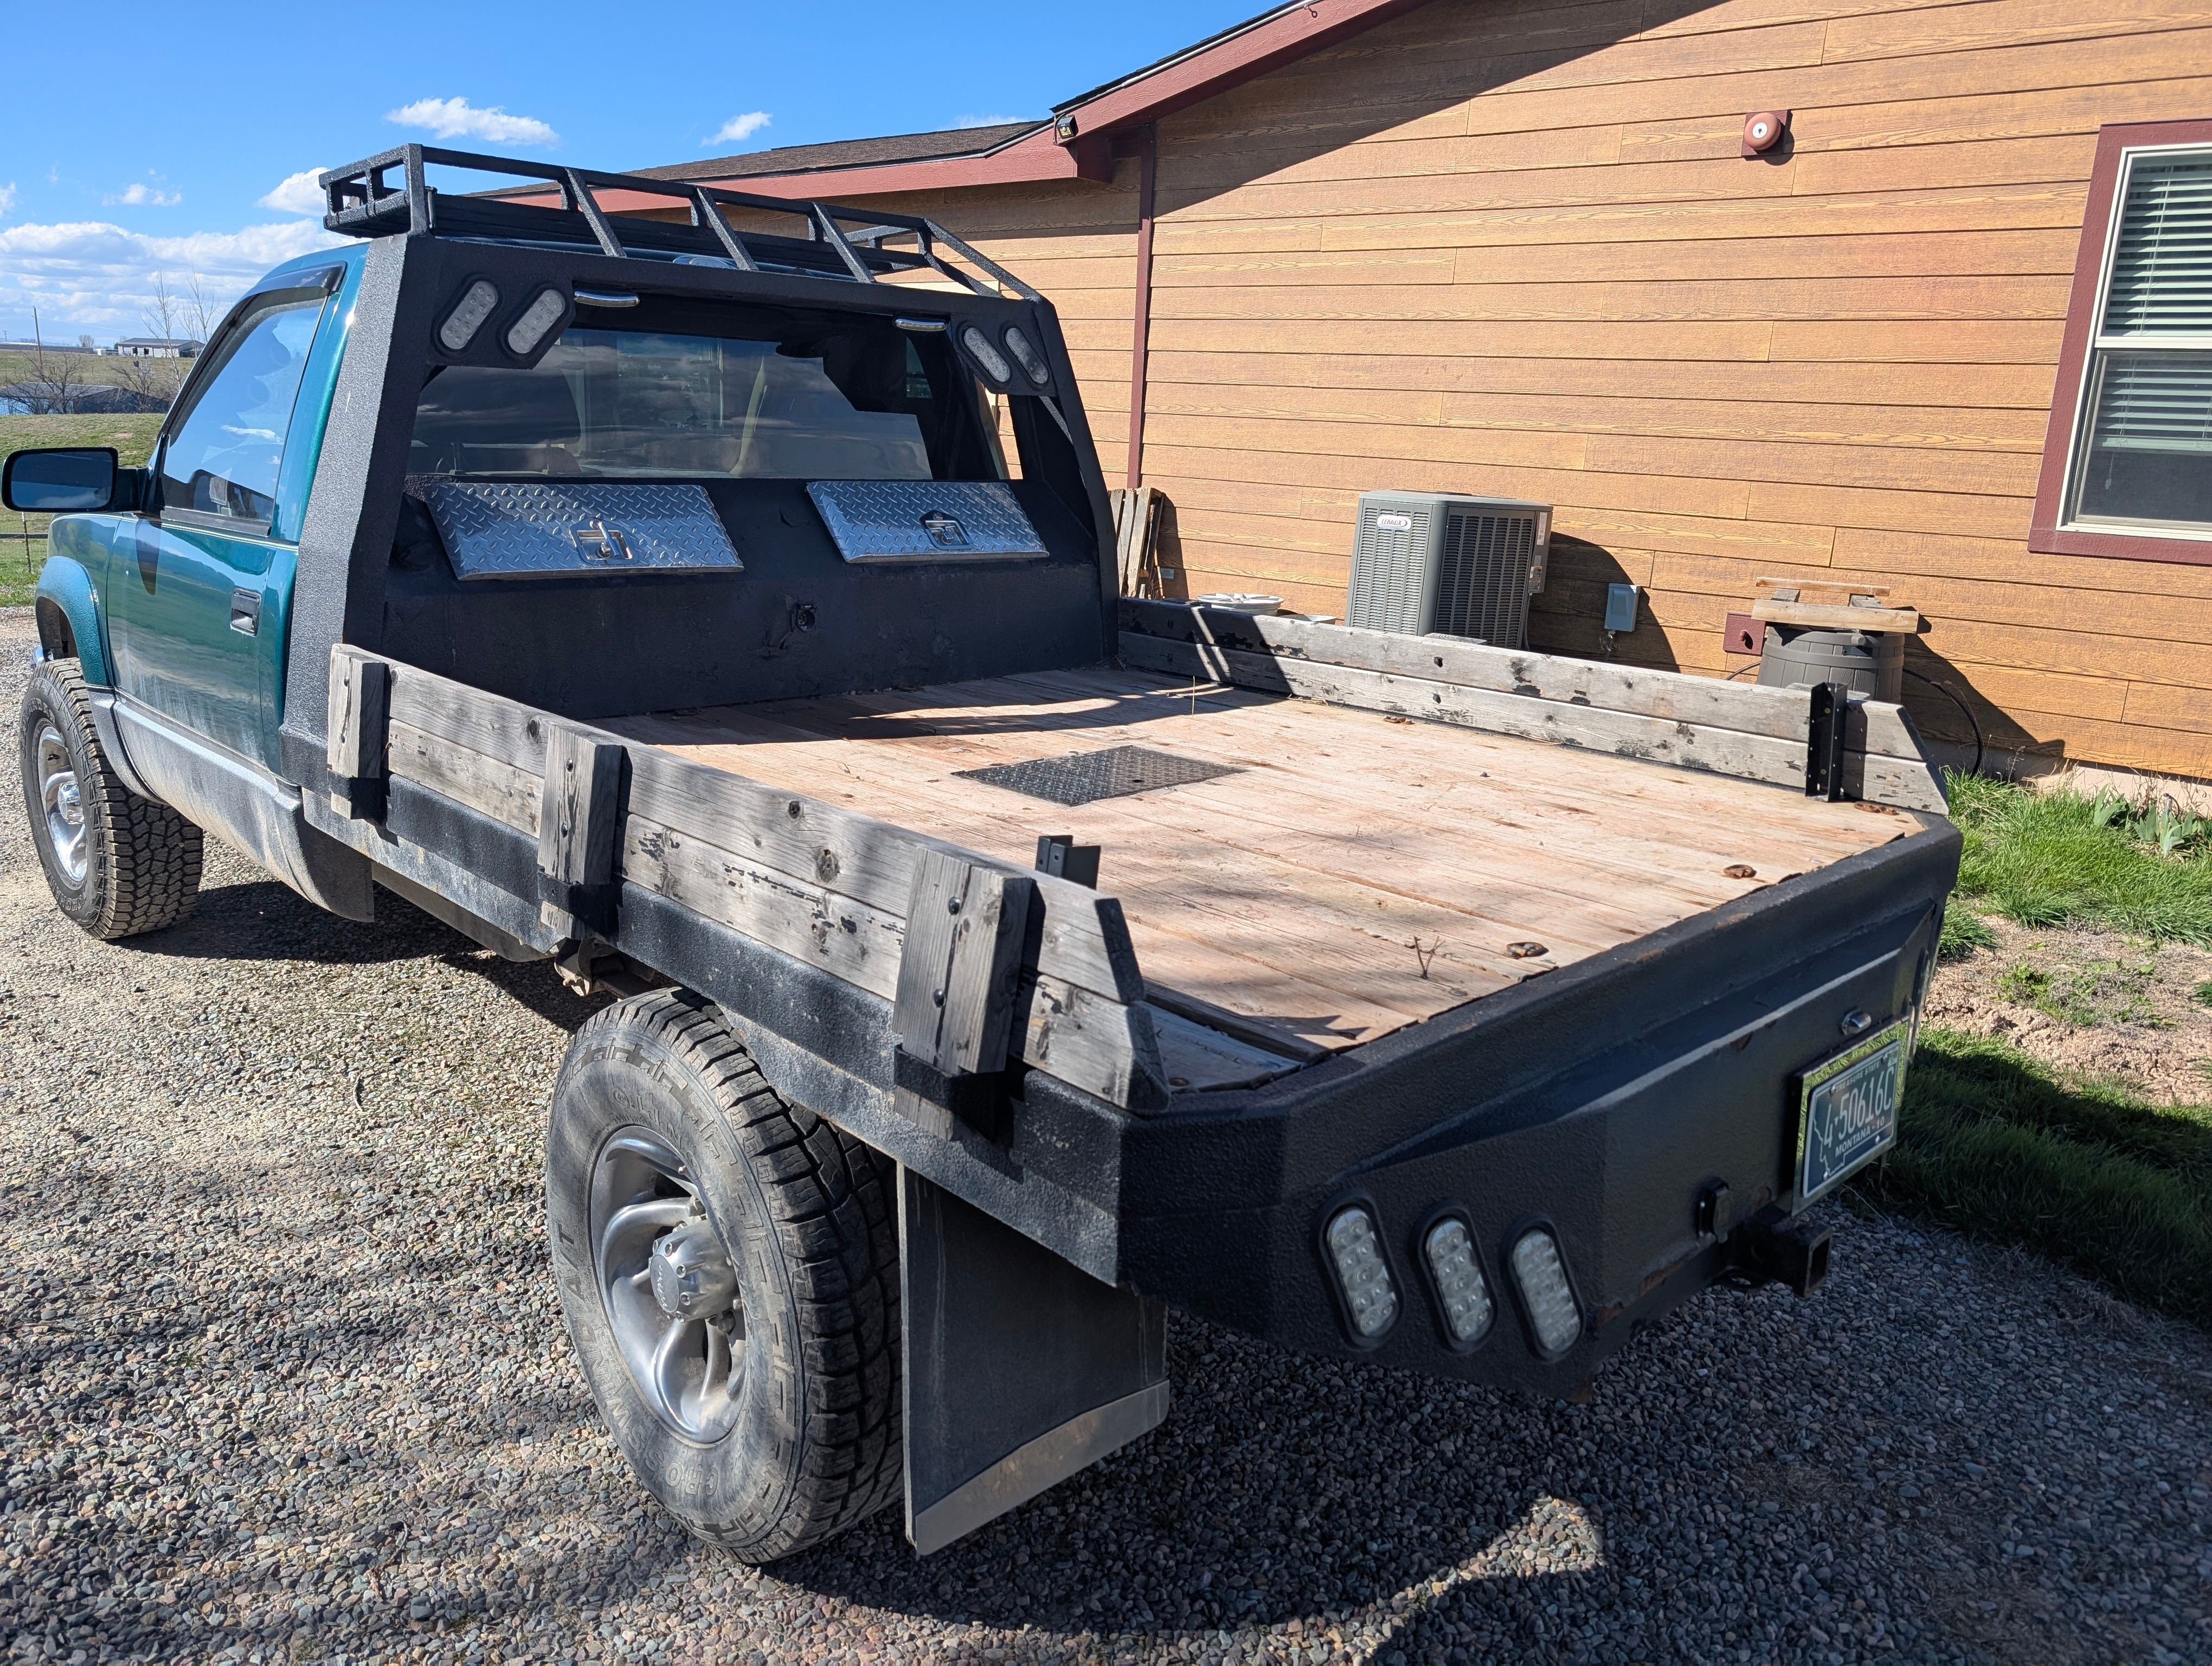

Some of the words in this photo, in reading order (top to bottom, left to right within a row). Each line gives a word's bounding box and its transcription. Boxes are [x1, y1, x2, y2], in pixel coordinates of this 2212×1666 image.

[1865, 1061, 1879, 1075] STATE
[1835, 1126, 1871, 1157] MONTANA
[577, 1318, 719, 1496] CROSSWIND
